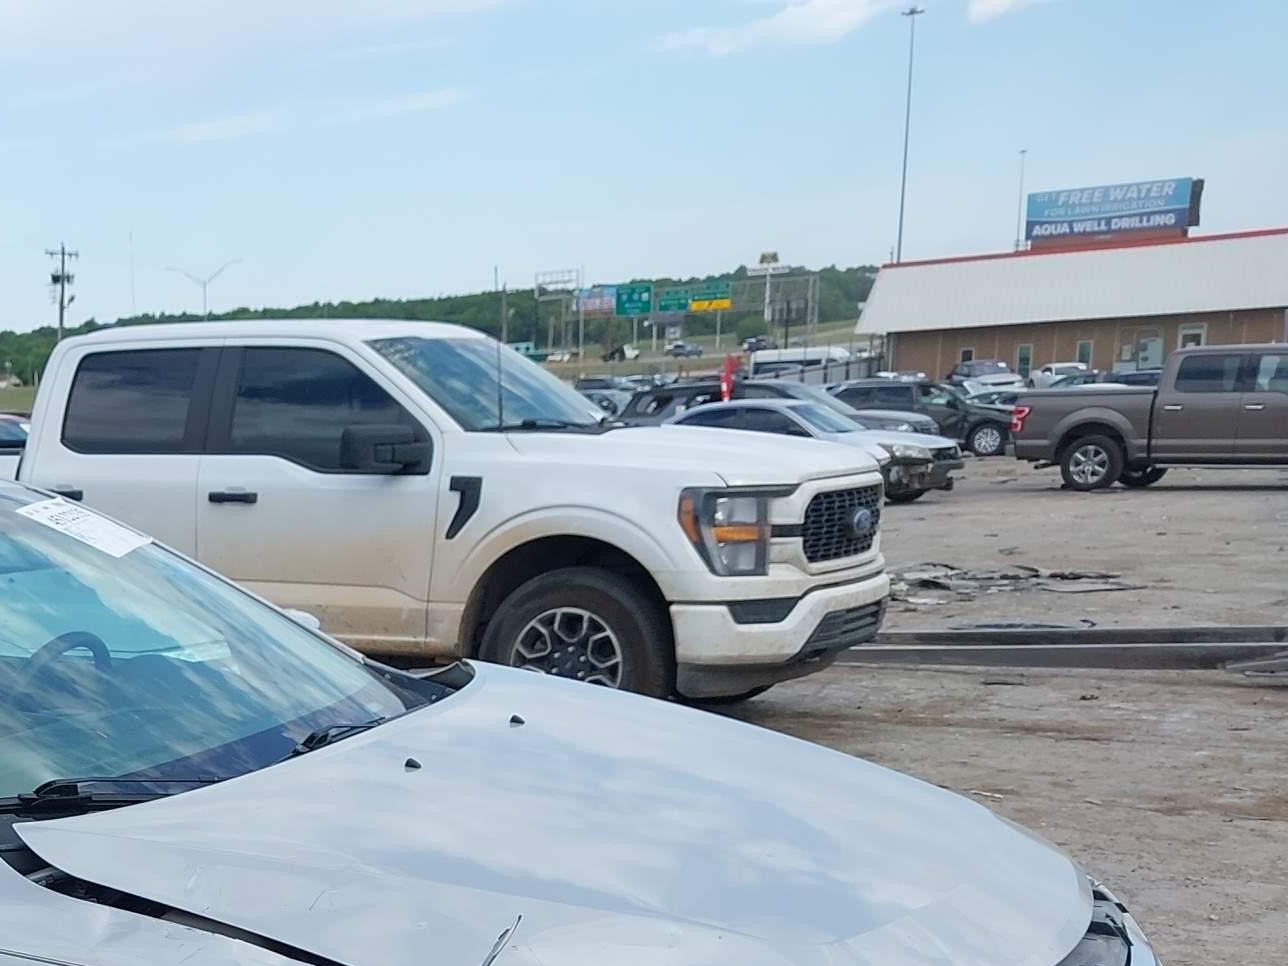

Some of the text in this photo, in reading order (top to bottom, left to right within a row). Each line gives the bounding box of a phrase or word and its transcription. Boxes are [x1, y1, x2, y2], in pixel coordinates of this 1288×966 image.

[1058, 187, 1104, 206] FREE
[1110, 181, 1177, 201] WATER
[1031, 213, 1176, 236] AQUA WELL DRILLING
